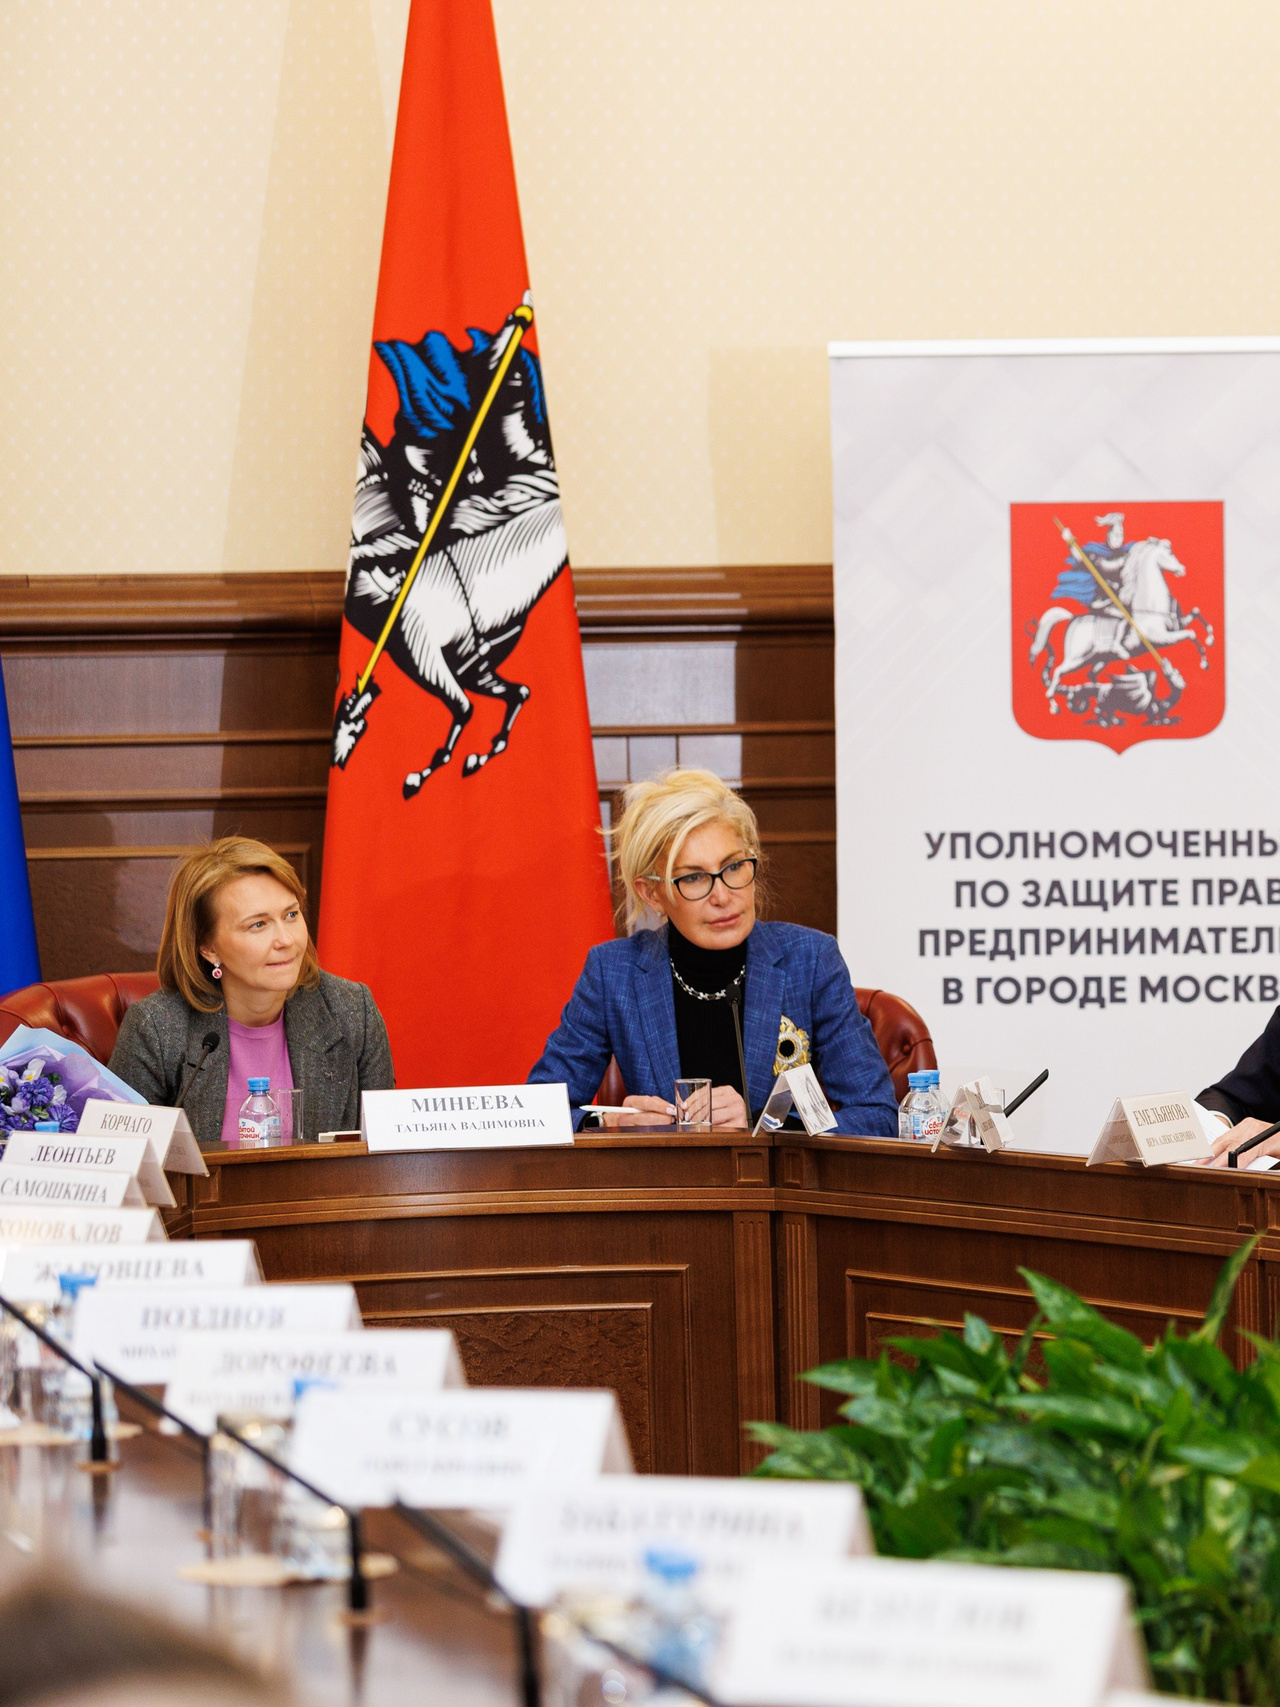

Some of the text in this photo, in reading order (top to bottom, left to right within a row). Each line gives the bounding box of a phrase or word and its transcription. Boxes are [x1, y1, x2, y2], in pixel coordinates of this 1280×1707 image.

[954, 880, 1009, 908] ПО
[1022, 879, 1180, 911] ЗАЩИТЕ
[942, 977, 963, 1004] В
[976, 976, 1127, 1009] ГОРОДЕ
[411, 1094, 525, 1113] МИНЕЕВА
[100, 1113, 152, 1134] КОРЧАГО
[394, 1118, 546, 1133] ТАТЬЯНА ВАДИМОВНА
[1133, 1103, 1190, 1127] ЕМЕЛЬЯНОВА
[30, 1145, 117, 1165] ЛЕОНТЬЕВ
[0, 1177, 108, 1203] САМОШКИНА
